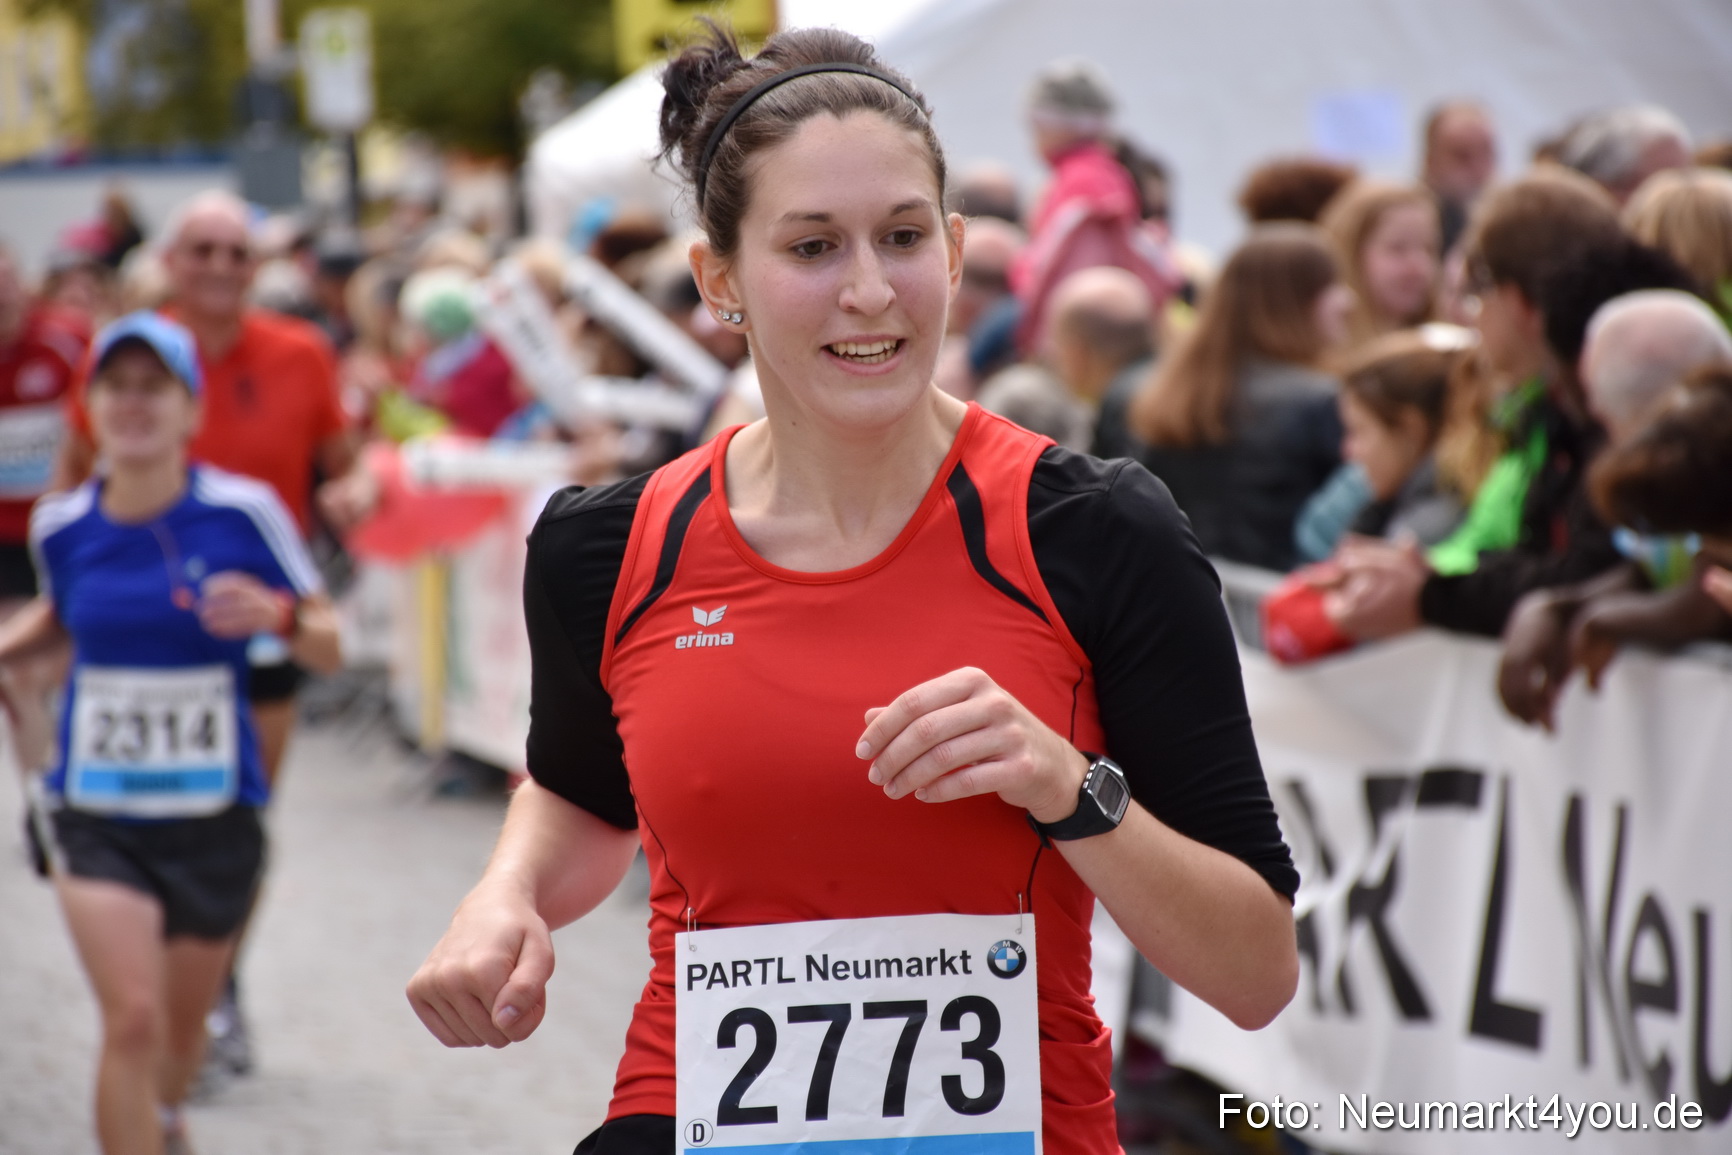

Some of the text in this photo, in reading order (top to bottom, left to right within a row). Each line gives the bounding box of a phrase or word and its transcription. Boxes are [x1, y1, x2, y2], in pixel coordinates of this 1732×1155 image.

[675, 631, 734, 649] erima
[93, 708, 217, 761] 2314
[686, 948, 972, 992] PARTL Neumarkt
[716, 995, 1006, 1127] 2773
[692, 1123, 705, 1144] D
